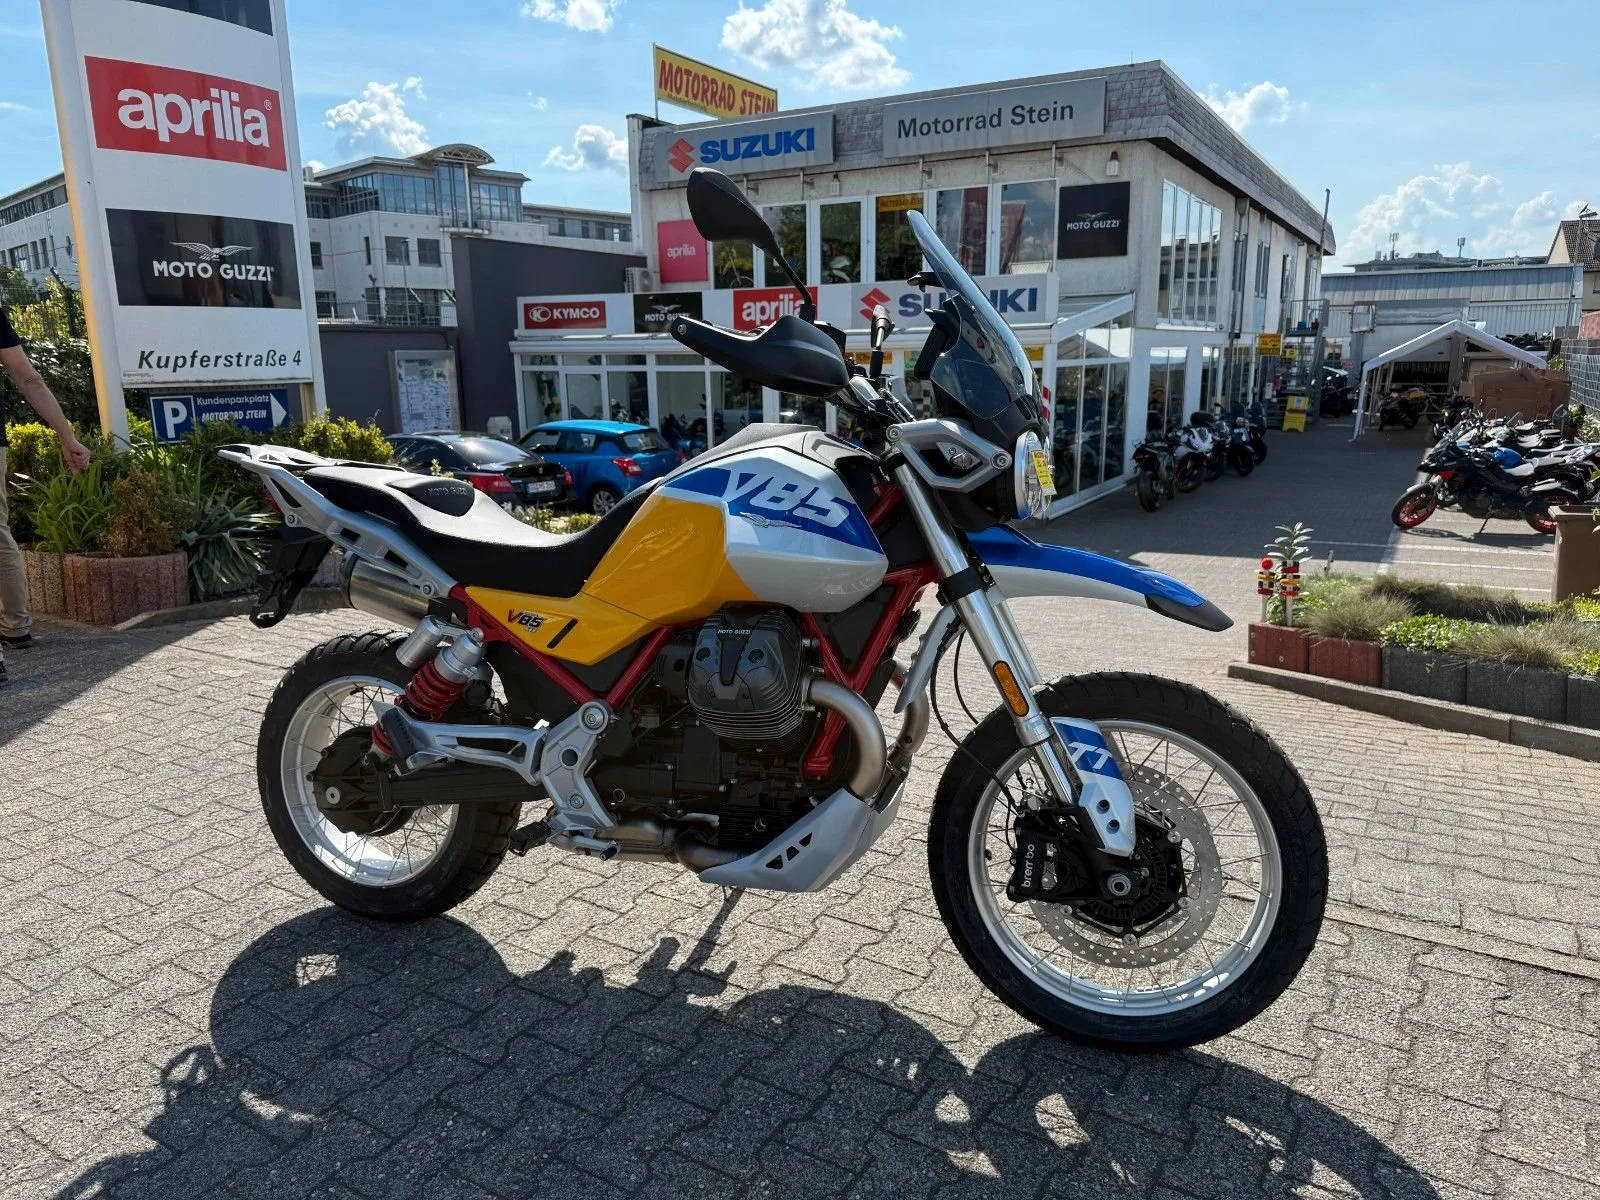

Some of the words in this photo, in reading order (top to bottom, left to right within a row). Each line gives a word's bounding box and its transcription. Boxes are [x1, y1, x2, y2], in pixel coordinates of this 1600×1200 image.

[658, 59, 736, 113] MOTORRAD
[739, 88, 775, 115] STEIN
[117, 87, 270, 148] aprilia
[897, 108, 1002, 139] Motorrad
[1011, 101, 1074, 126] Stein
[700, 127, 815, 164] SUZUKI
[1066, 221, 1091, 230] MOTO
[1093, 220, 1120, 229] GUZZI
[667, 243, 696, 259] aprilia
[153, 259, 213, 279] MOTO
[220, 262, 272, 282] GUZZI
[553, 307, 600, 319] KYMCO
[898, 287, 1038, 318] SUKI
[644, 313, 665, 321] MOTO
[138, 349, 287, 373] Kupferstraße
[293, 350, 302, 366] 4
[196, 394, 270, 406] Kundenparkplatz
[162, 401, 188, 439] P
[201, 411, 244, 422] MOTORAD
[245, 409, 267, 419] STEIN
[720, 469, 850, 528] V85
[508, 609, 546, 628] V85
[1068, 741, 1113, 770] TT
[1021, 843, 1036, 888] brembo
